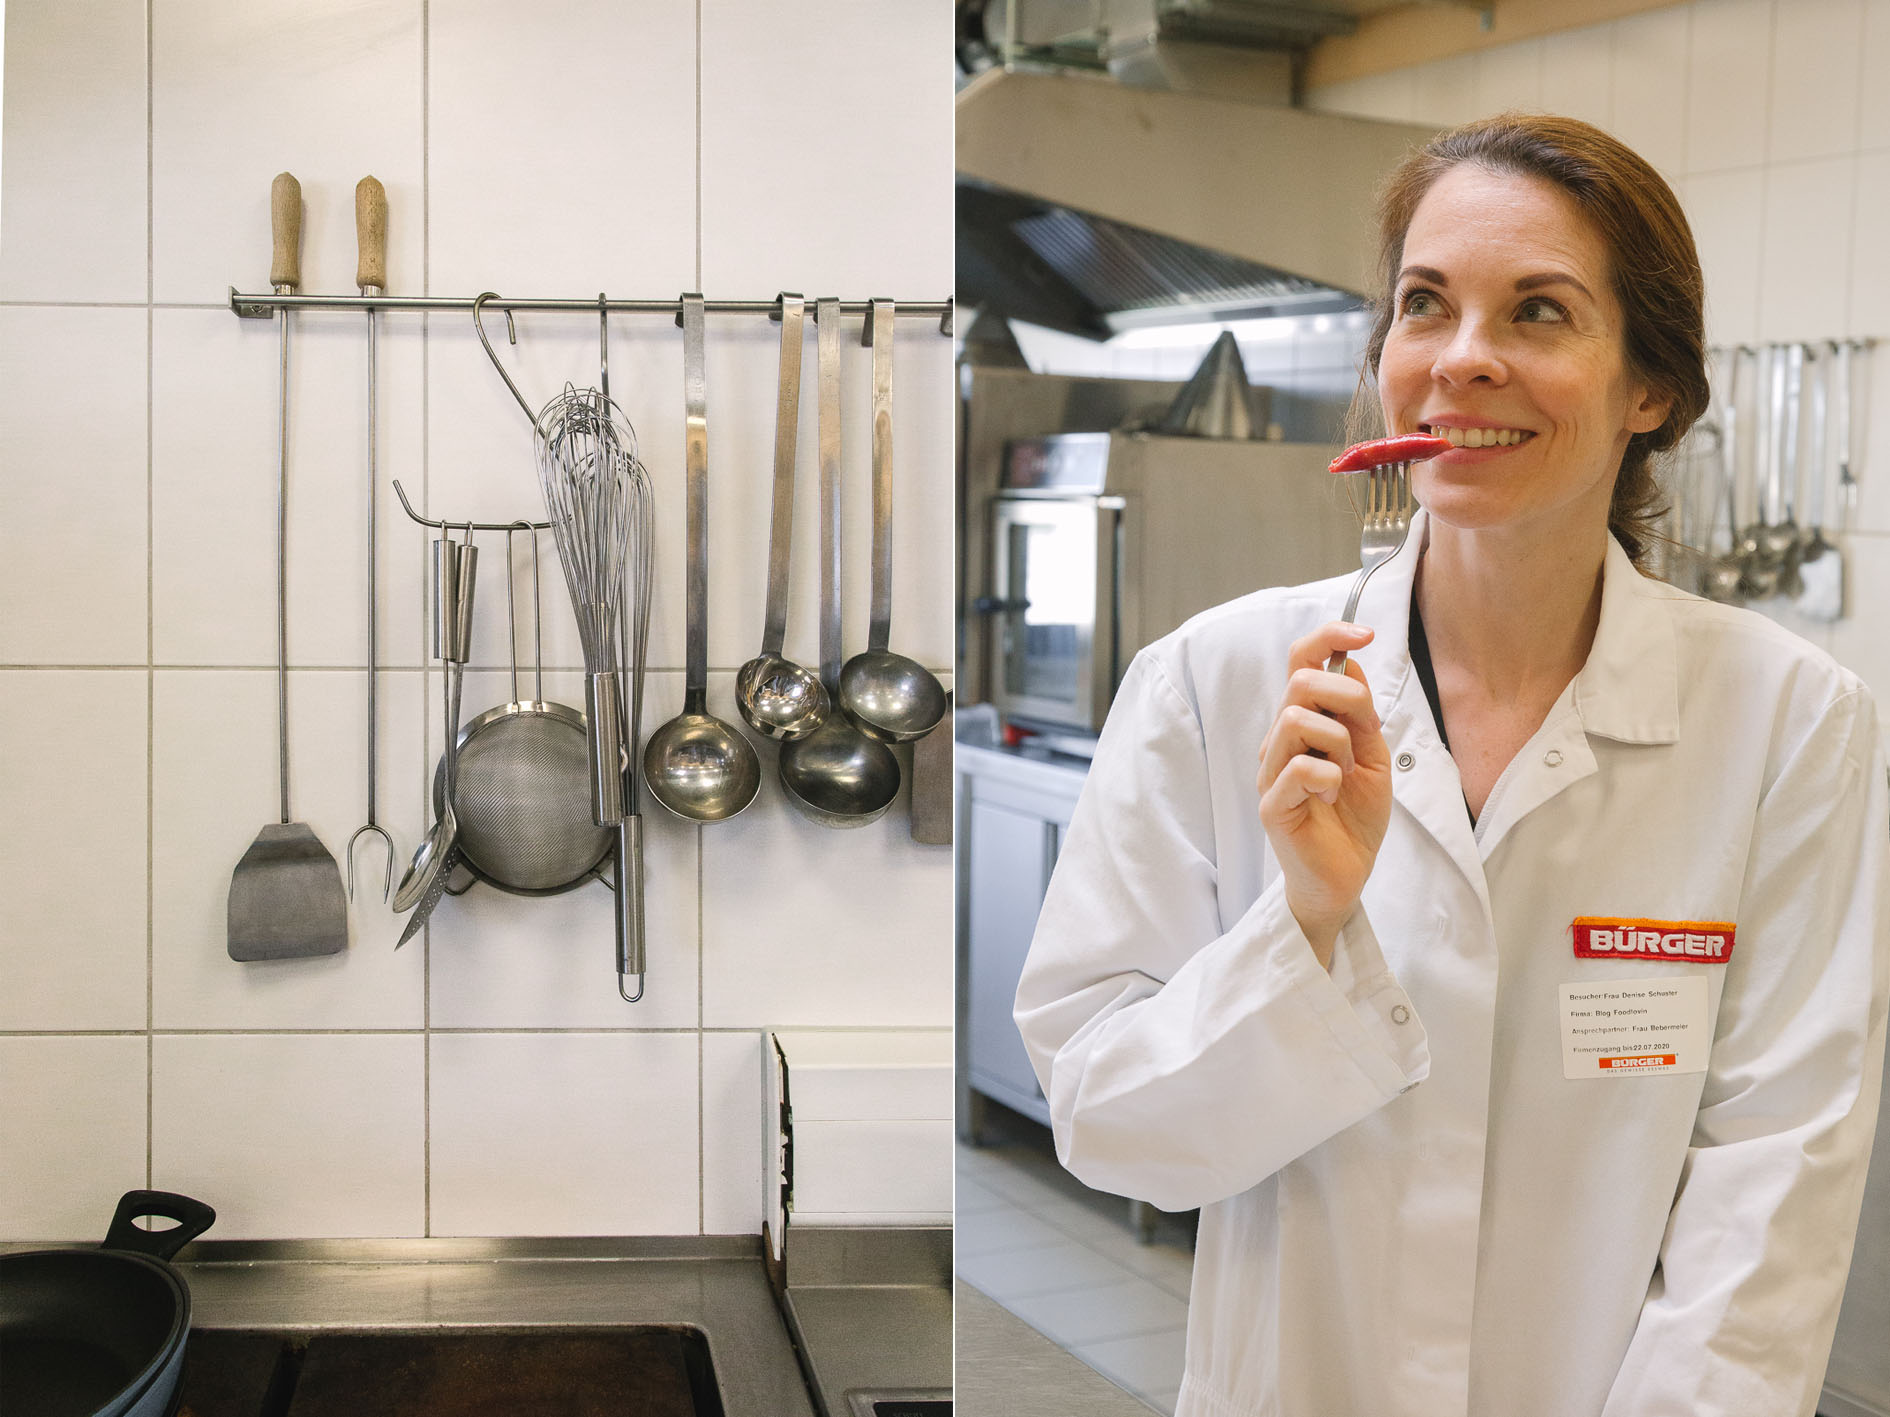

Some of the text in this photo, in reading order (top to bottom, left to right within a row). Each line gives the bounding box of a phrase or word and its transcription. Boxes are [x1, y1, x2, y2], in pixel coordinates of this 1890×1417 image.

[1590, 926, 1725, 957] BÜRGER
[1622, 991, 1646, 999] Denise
[1648, 990, 1678, 998] Schuster
[1595, 1010, 1611, 1018] Blog
[1613, 1008, 1648, 1016] Foodlovin
[1571, 1023, 1689, 1036] Ansprechpartner: Frau Bebermeier
[1573, 1045, 1621, 1054] Firmenzugang
